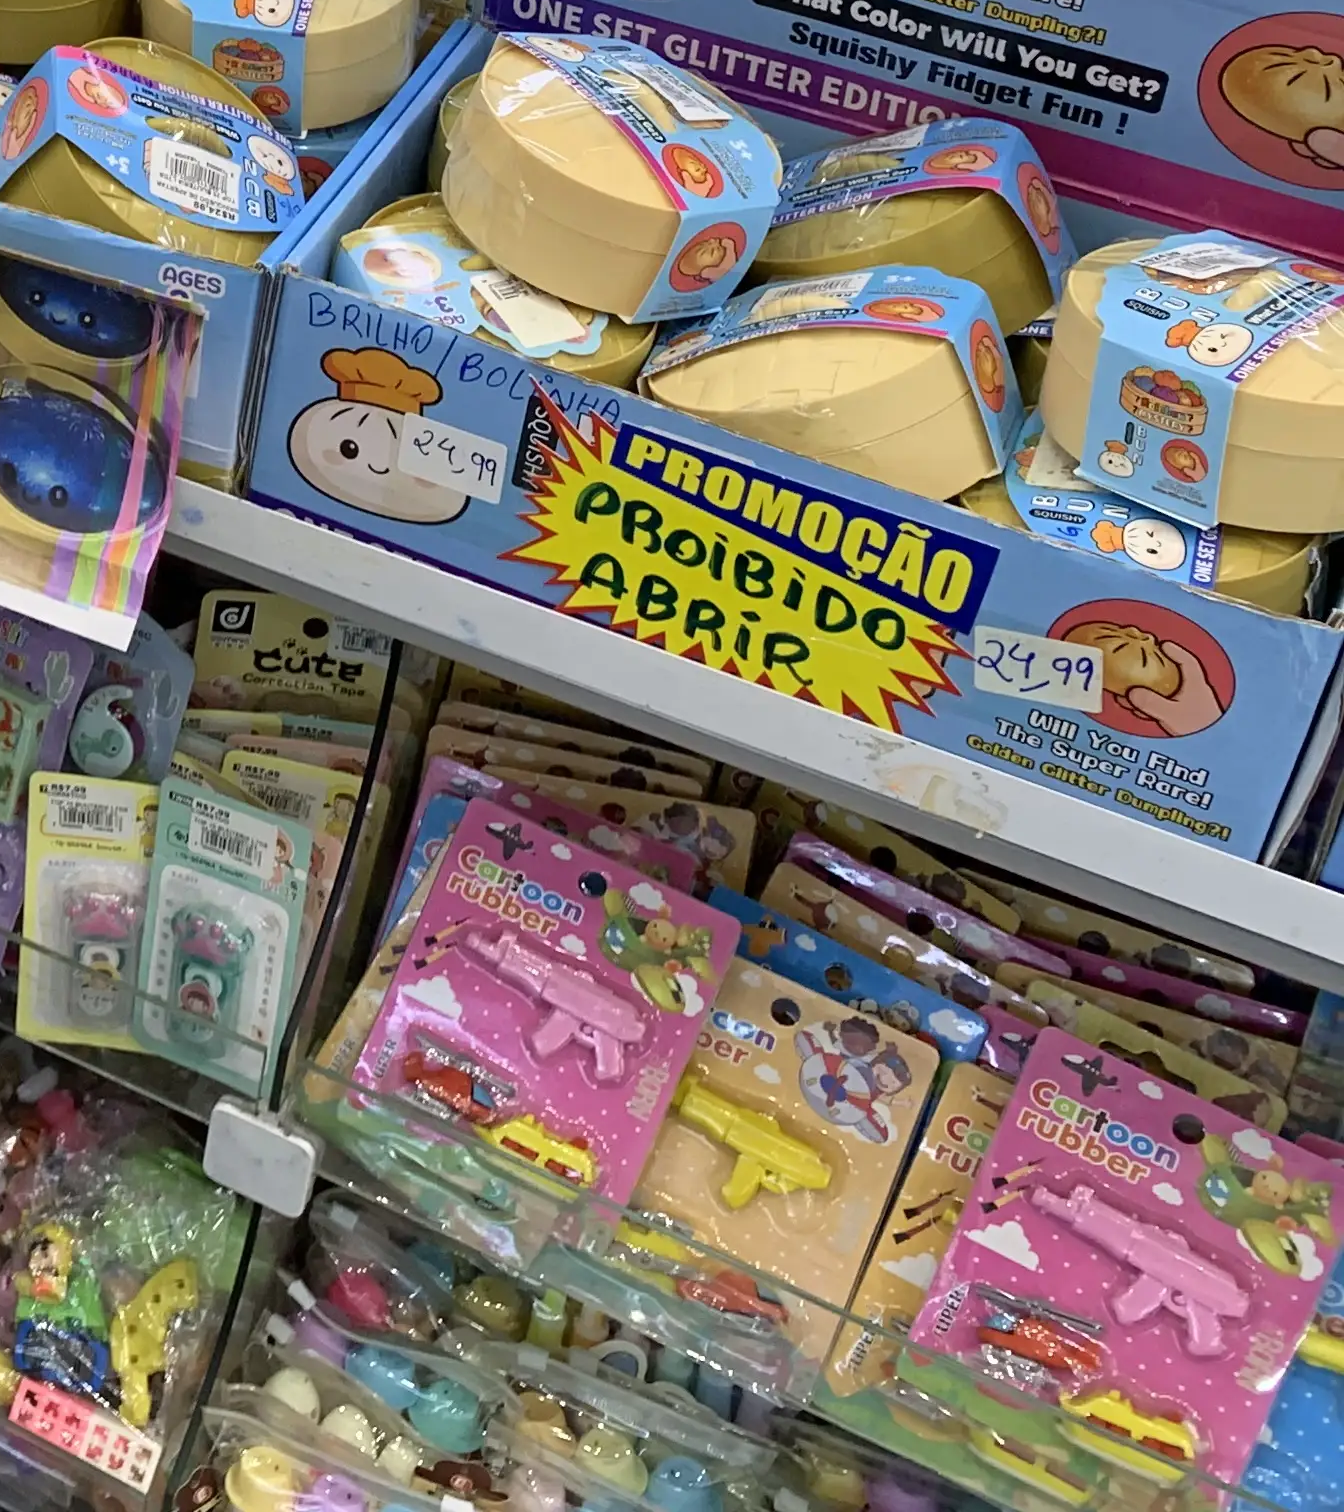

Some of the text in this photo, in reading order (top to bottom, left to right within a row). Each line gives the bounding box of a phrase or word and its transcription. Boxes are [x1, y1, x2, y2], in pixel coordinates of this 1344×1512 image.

[295, 7, 311, 32] ONE
[984, 0, 1108, 46] Dumpling?!
[591, 15, 658, 49] SET
[664, 31, 814, 98] GLITTER
[817, 72, 972, 128] EDITIO
[787, 21, 920, 82] Squishy
[927, 58, 1036, 111] Fidget
[1042, 90, 1105, 129] Fun
[939, 20, 1008, 65] Will
[1014, 42, 1080, 86] You
[1085, 59, 1164, 102] Get?
[158, 82, 204, 106] EDITION
[204, 95, 255, 125] GLITTER
[255, 118, 275, 137] SET
[105, 154, 131, 175] 3+
[192, 199, 237, 223] R$24,99
[772, 190, 874, 226] LITTER EDITION
[162, 266, 222, 295] AGES
[1134, 286, 1221, 324] BUN
[307, 291, 435, 355] BRILHO
[1126, 300, 1171, 320] SQUISHY
[1233, 340, 1274, 381] ONE SET
[412, 429, 498, 486] 24,99
[624, 433, 974, 615] PROMOÇÃO
[1031, 494, 1132, 520] BUN
[1032, 508, 1086, 525] SQUISHY
[1192, 532, 1215, 584] ONE SET
[242, 672, 366, 697] Correction Tape
[975, 638, 1096, 693] 24,99
[995, 716, 1214, 811] The Super Rare!
[1027, 707, 1210, 789] Will You Find
[966, 734, 1232, 842] Golden Glitter Dumpling?!
[446, 870, 560, 938] rubber
[456, 844, 586, 926] Cartoon
[1016, 1106, 1151, 1186] rubber
[1029, 1077, 1181, 1173] Cartoon
